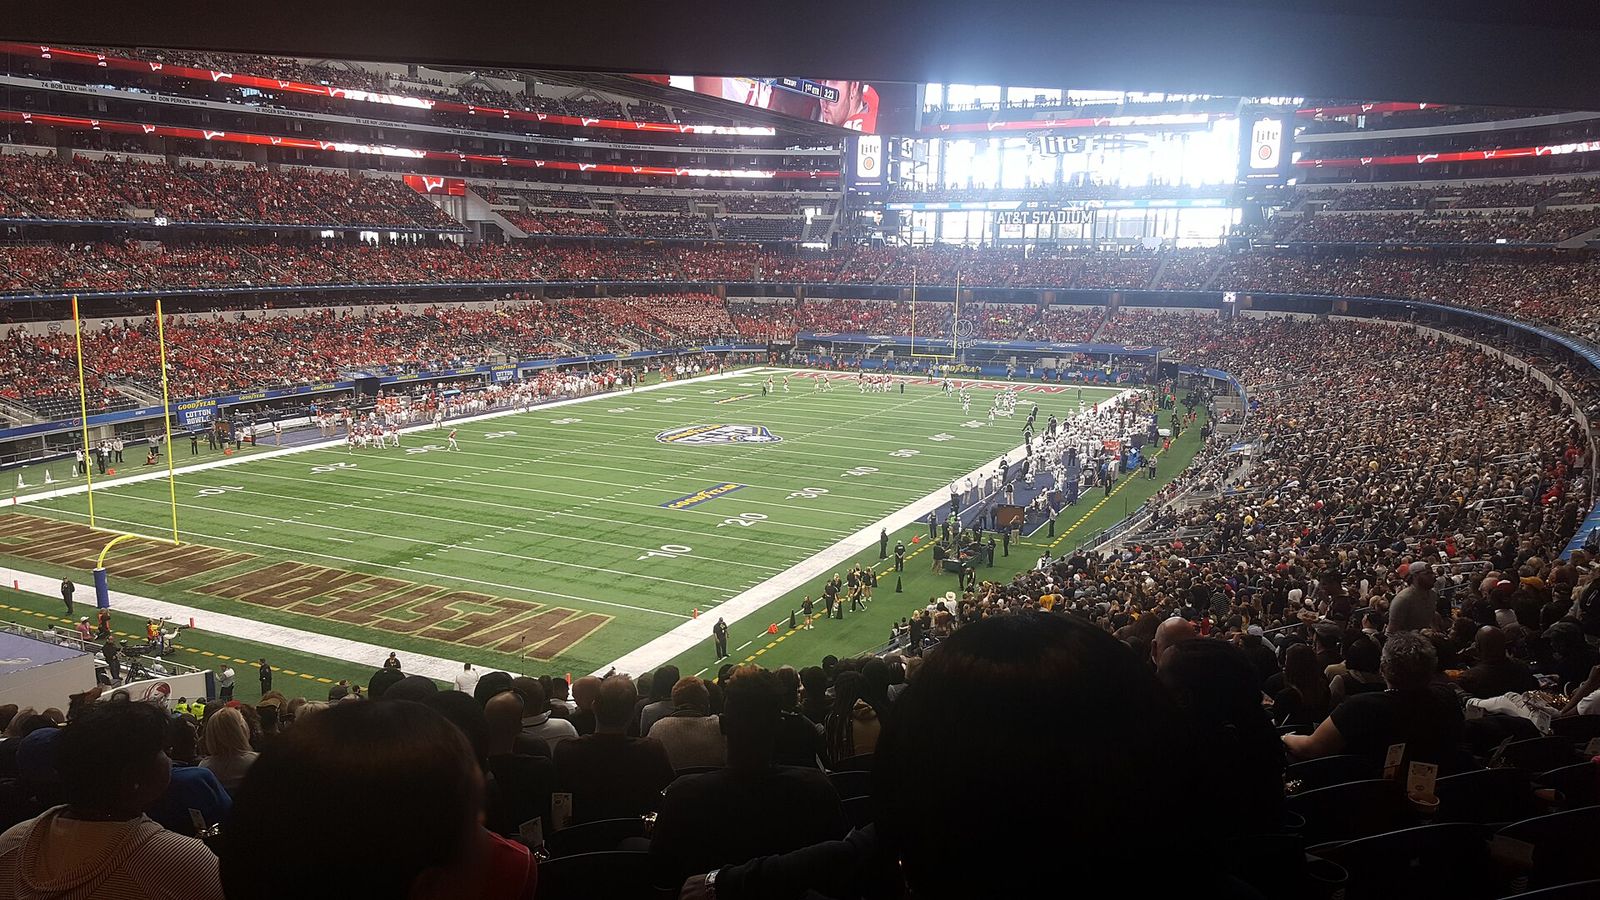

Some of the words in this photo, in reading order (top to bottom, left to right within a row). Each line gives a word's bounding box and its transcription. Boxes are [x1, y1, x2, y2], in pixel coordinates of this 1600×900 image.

[1040, 136, 1081, 157] Lite
[997, 211, 1029, 224] AT&T
[1032, 211, 1094, 224] STADIUM
[946, 338, 979, 349] Astate
[177, 400, 216, 411] GOODYEAR
[185, 408, 212, 419] COTTON
[186, 416, 207, 425] BOWL
[668, 483, 738, 510] GOODYEAR
[791, 487, 829, 499] 30
[724, 512, 769, 527] 20
[647, 544, 693, 559] 10
[187, 560, 616, 662] WESTERN
